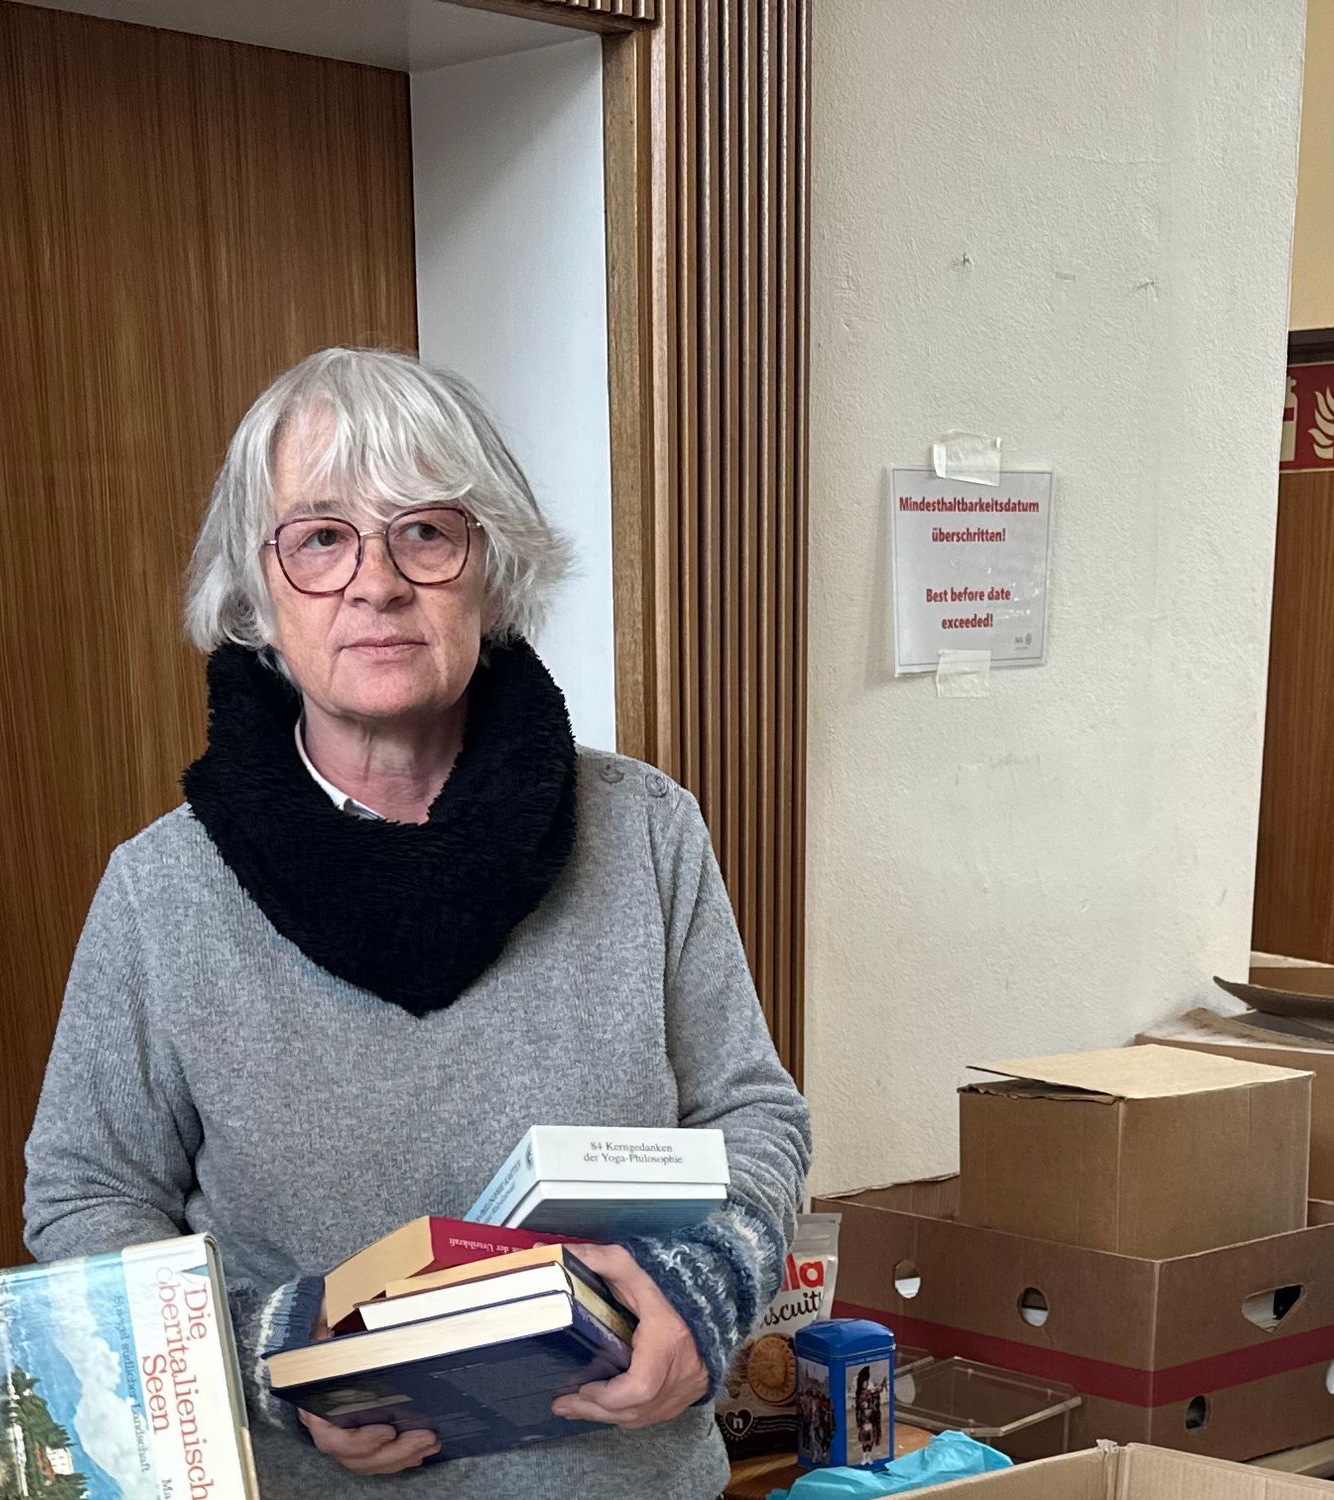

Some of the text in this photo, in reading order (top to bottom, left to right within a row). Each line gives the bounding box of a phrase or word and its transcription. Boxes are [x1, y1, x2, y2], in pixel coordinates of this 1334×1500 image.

[899, 497, 1039, 513] Mindesthaltbarkeitsdatum
[932, 527, 1005, 543] überschritten!
[926, 587, 1011, 602] Best before date
[941, 613, 993, 629] exceeded!
[590, 1141, 673, 1154] 84 Kerngedanken
[583, 1153, 684, 1166] der Yoga-Philosophie
[184, 1285, 209, 1341] Die
[141, 1354, 170, 1434] Seen
